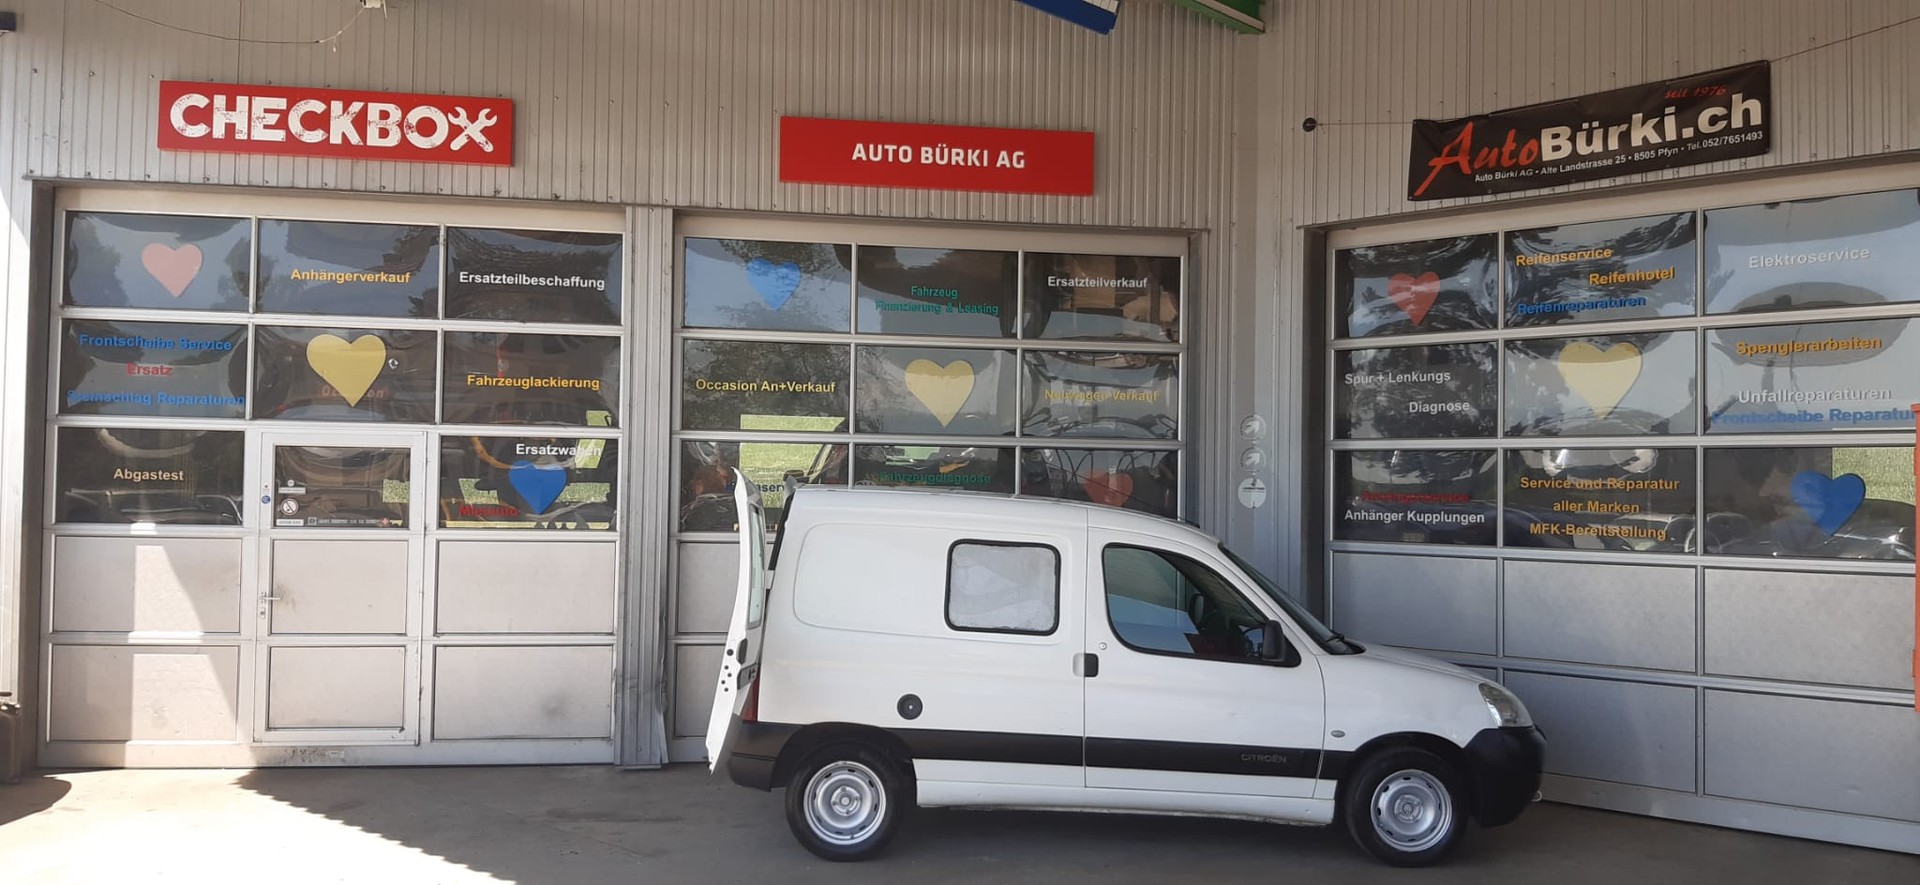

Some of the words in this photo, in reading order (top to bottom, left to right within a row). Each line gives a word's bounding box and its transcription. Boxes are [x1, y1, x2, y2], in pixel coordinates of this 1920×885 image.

[169, 93, 498, 153] CHECKBOX
[852, 143, 913, 164] AUTO
[920, 143, 989, 168] BÜRKI
[996, 150, 1025, 169] AG
[1475, 172, 1493, 182] Auto
[1495, 168, 1517, 179] Bürki
[1519, 168, 1533, 177] AG
[1541, 166, 1558, 174] Alte
[1560, 159, 1613, 172] Landstrasse
[1615, 155, 1626, 164] 25
[1634, 151, 1656, 161] 8505
[1658, 147, 1678, 158] Pfyn
[1516, 247, 1612, 266] Reifenservice
[1748, 247, 1871, 268] Elektroservice
[291, 268, 411, 285] Anhängerverkauf
[459, 271, 605, 290] Ersatzteilbeschaffung
[1047, 275, 1148, 290] Ersatzteilverkauf
[1589, 267, 1675, 286] Reifenhotel
[911, 286, 958, 299] Fahrzeug
[958, 302, 999, 315] Leasing
[1517, 296, 1647, 315] Reifenreparaturen
[79, 334, 174, 350] Frontscheibe
[179, 337, 233, 350] Service
[1736, 335, 1883, 357] Spenglerarbeiten
[126, 361, 173, 376] Ersatz
[467, 374, 600, 391] Fahrzeuglackierung
[695, 378, 757, 391] Occasion
[761, 380, 836, 393] An+Verkauf
[1344, 373, 1373, 386] Spur
[1389, 370, 1451, 384] Lenkungs
[1738, 386, 1891, 405] Unfallreparaturen
[1409, 400, 1470, 414] Diagnose
[113, 467, 184, 483] Abgastest
[879, 470, 991, 486] Fahrzeugdiagnose
[1520, 477, 1571, 489] Service
[1575, 478, 1603, 489] und
[1607, 477, 1680, 491] Reparatur
[1553, 500, 1584, 513] aller
[1587, 501, 1640, 513] Marken
[1344, 509, 1404, 525] Anhänger
[1407, 510, 1485, 526] Kupplungen
[1529, 522, 1667, 541] MFK-Bereitstellung
